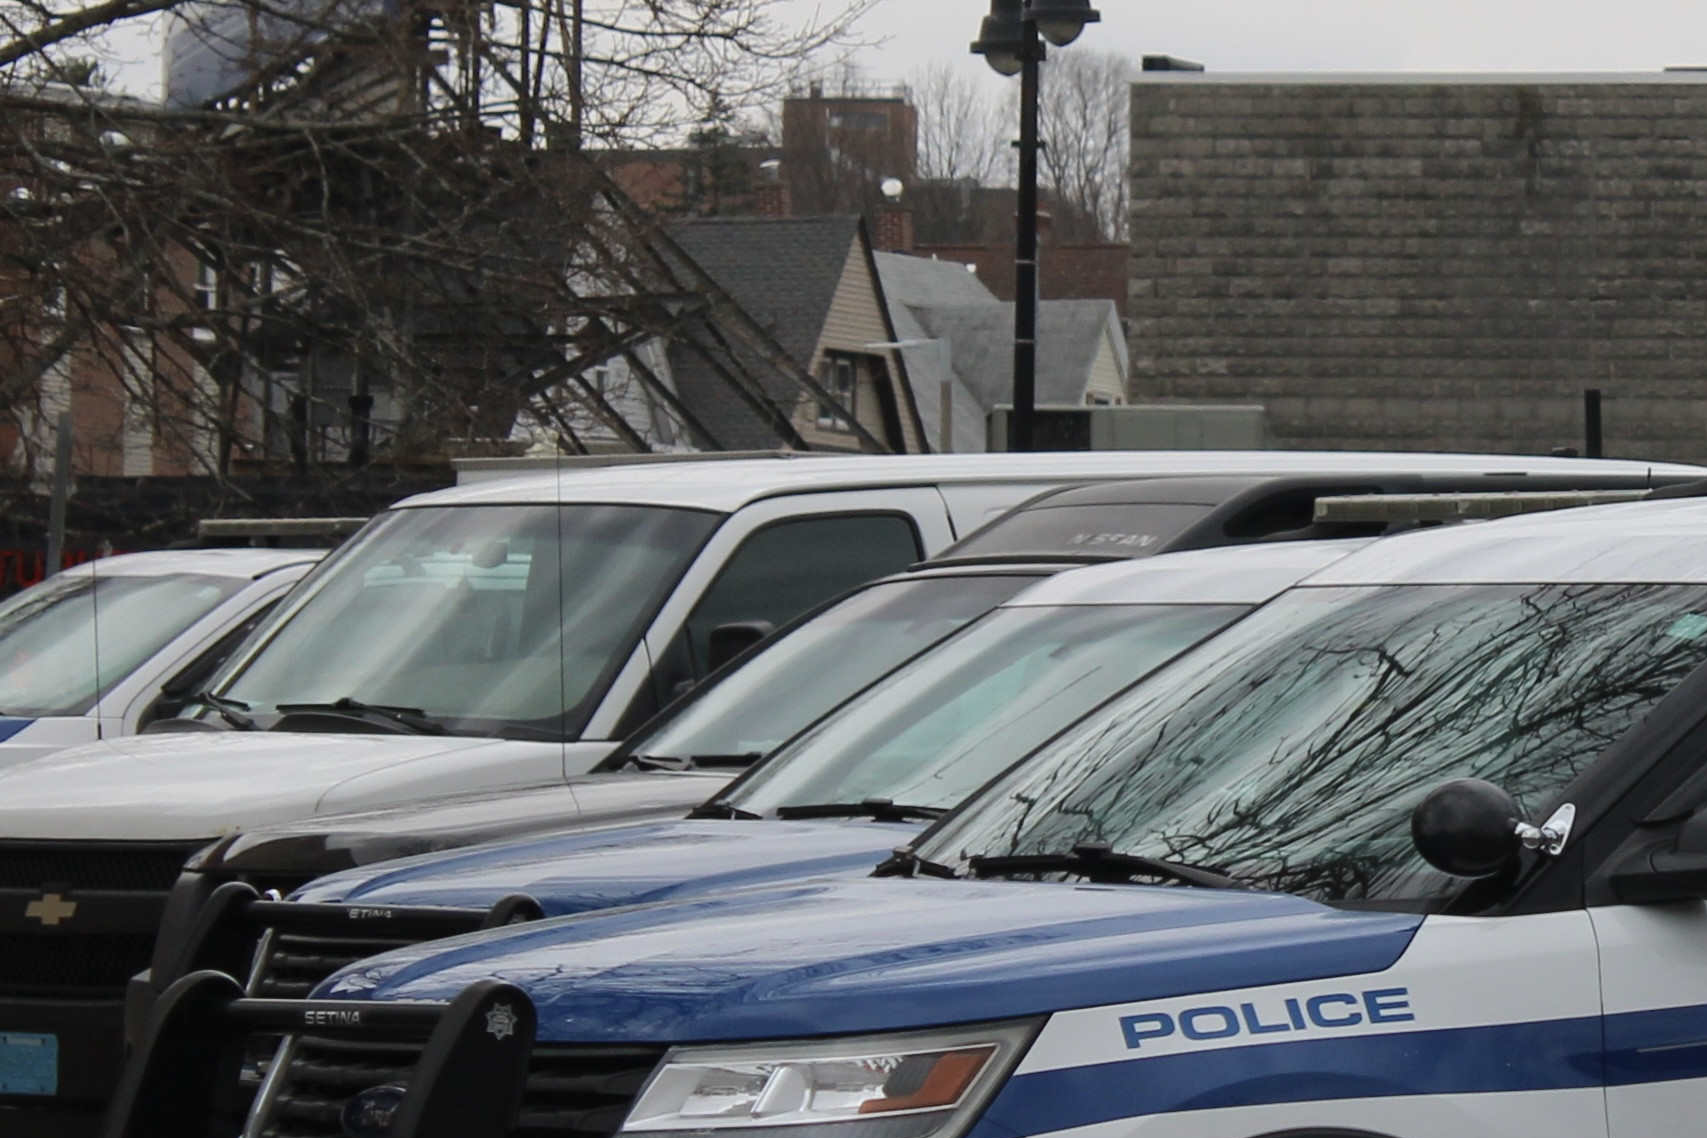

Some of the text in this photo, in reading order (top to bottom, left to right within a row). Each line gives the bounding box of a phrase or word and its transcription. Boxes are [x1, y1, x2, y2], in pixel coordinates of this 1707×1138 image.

[1065, 533, 1158, 547] NSSAN
[347, 908, 392, 919] ETINA
[304, 1011, 361, 1025] SETINA
[1119, 987, 1416, 1050] POLICE
